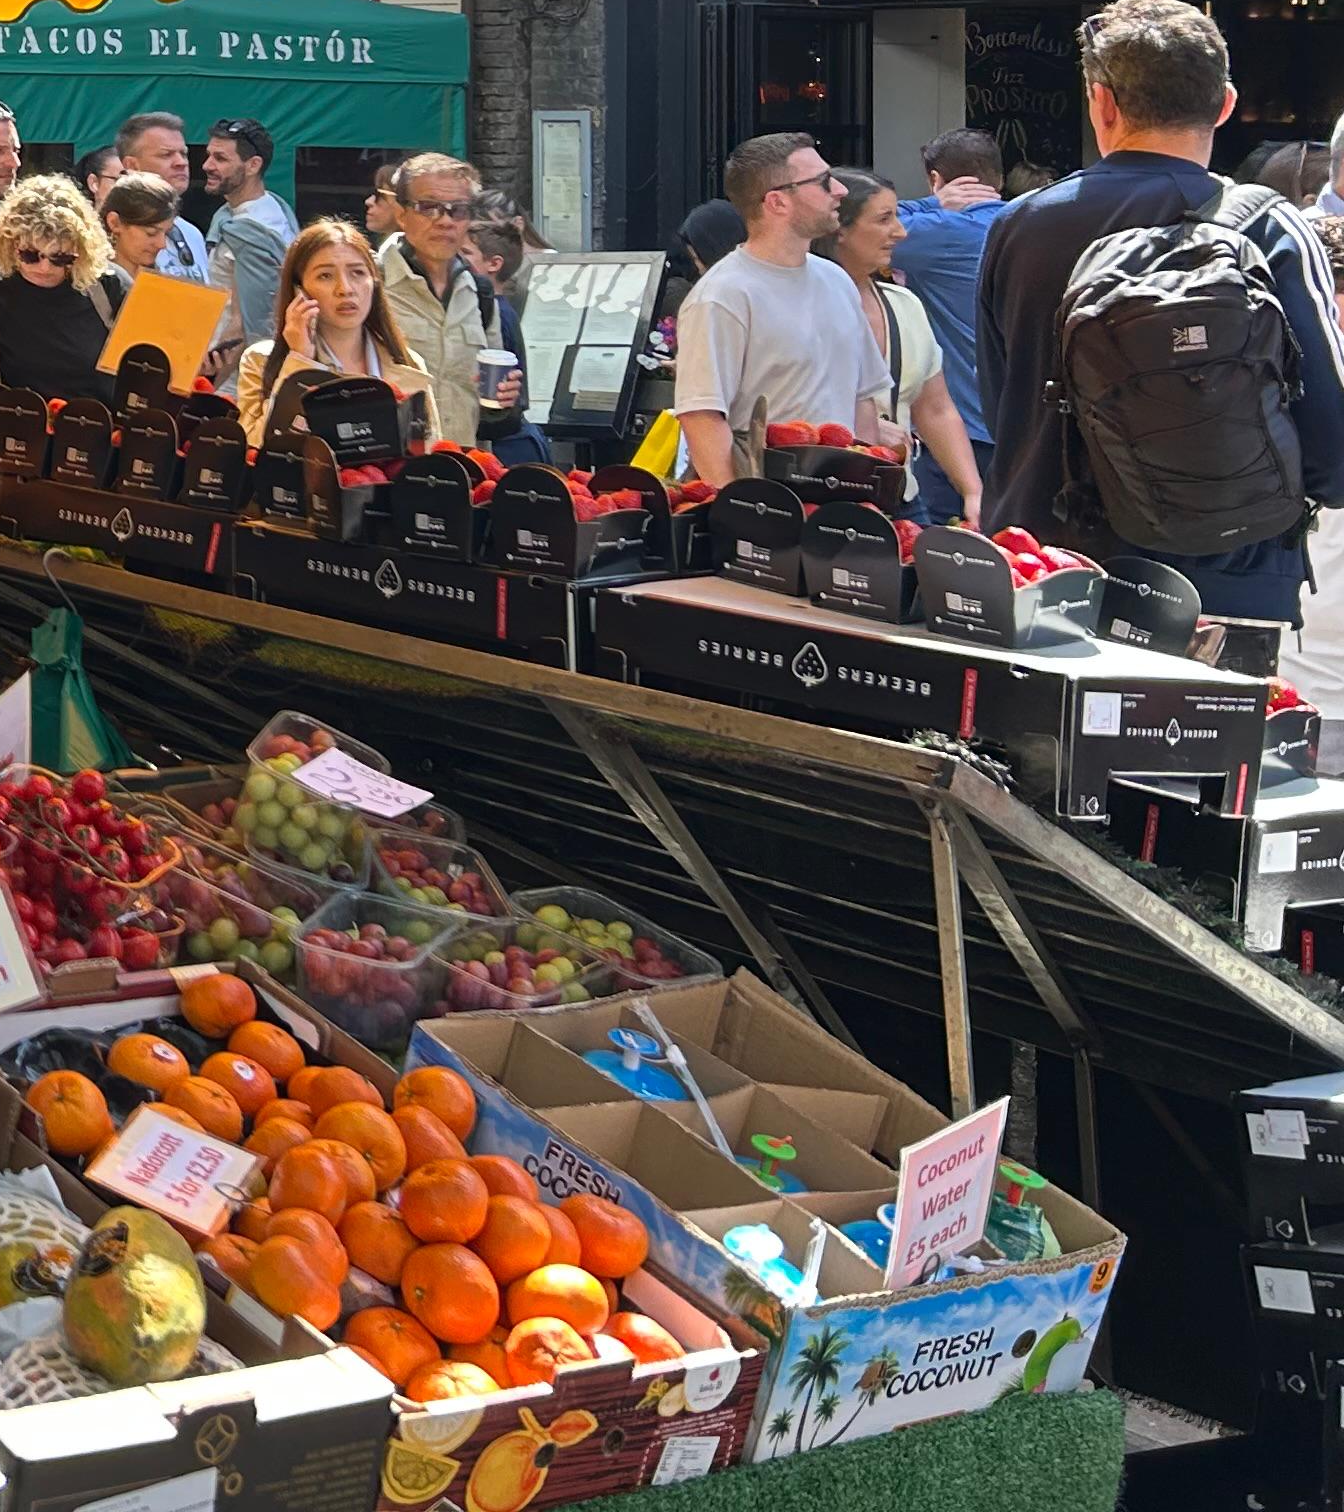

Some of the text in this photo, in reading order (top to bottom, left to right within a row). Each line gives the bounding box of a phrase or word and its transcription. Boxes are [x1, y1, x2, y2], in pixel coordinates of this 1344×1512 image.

[149, 29, 197, 57] EL
[219, 29, 375, 64] PASTÓR
[58, 508, 194, 545] BEEKERS BERRIES
[307, 559, 477, 603] BEEKERS BERRIES
[698, 639, 931, 697] BEEKERS BERRIES
[125, 1131, 185, 1187] Nadorcott
[164, 1145, 225, 1208] 5 for £2.50
[544, 1137, 621, 1205] FRESH
[917, 1133, 986, 1188] Coconut
[920, 1179, 972, 1222] Water
[905, 1211, 968, 1267] £5 each
[1095, 1262, 1109, 1282] 9
[912, 1326, 996, 1367] FRESH
[885, 1351, 1003, 1400] COCONUT
